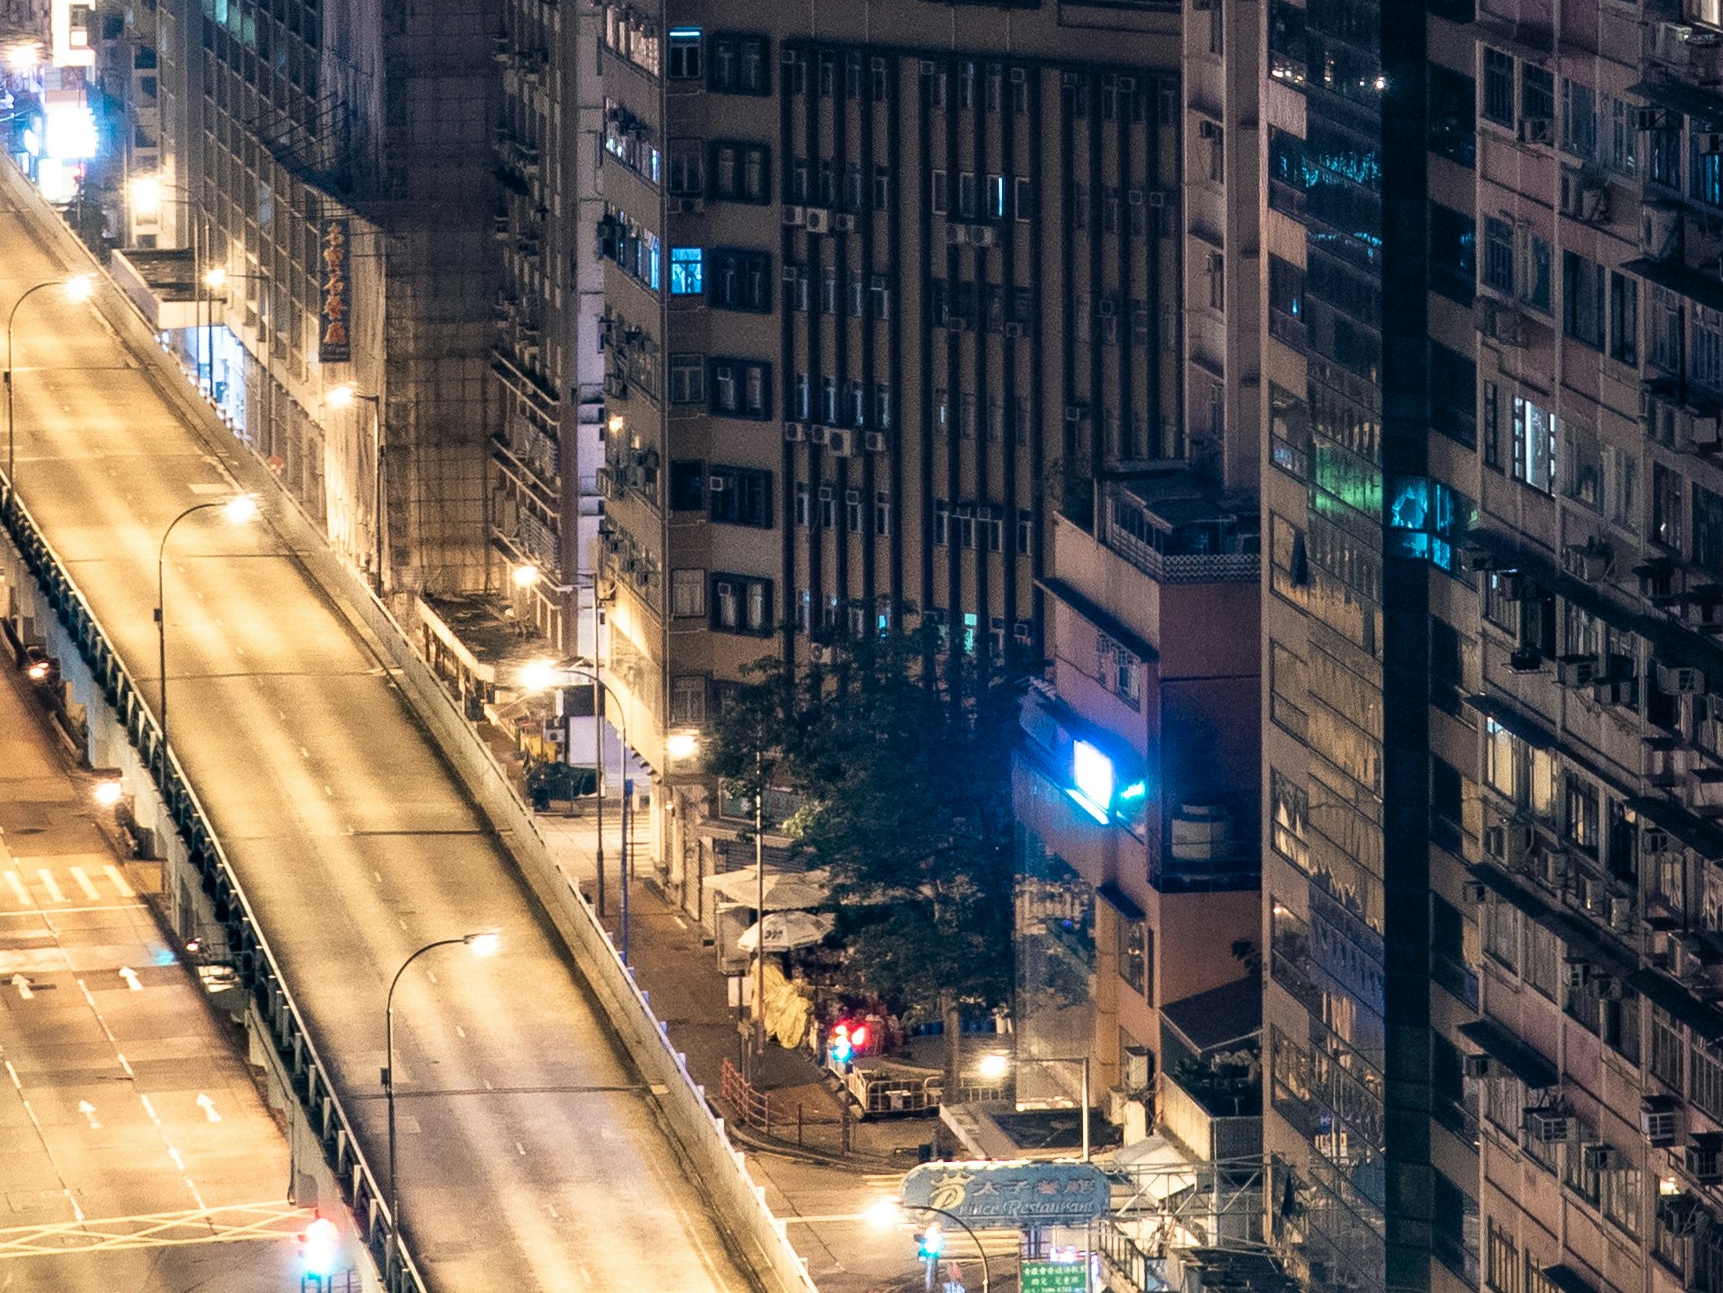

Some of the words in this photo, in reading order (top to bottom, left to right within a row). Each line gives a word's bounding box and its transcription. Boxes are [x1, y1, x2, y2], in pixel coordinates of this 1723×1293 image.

[973, 1179, 1096, 1195] 太子餐廳
[1003, 1200, 1094, 1218] Restaurant
